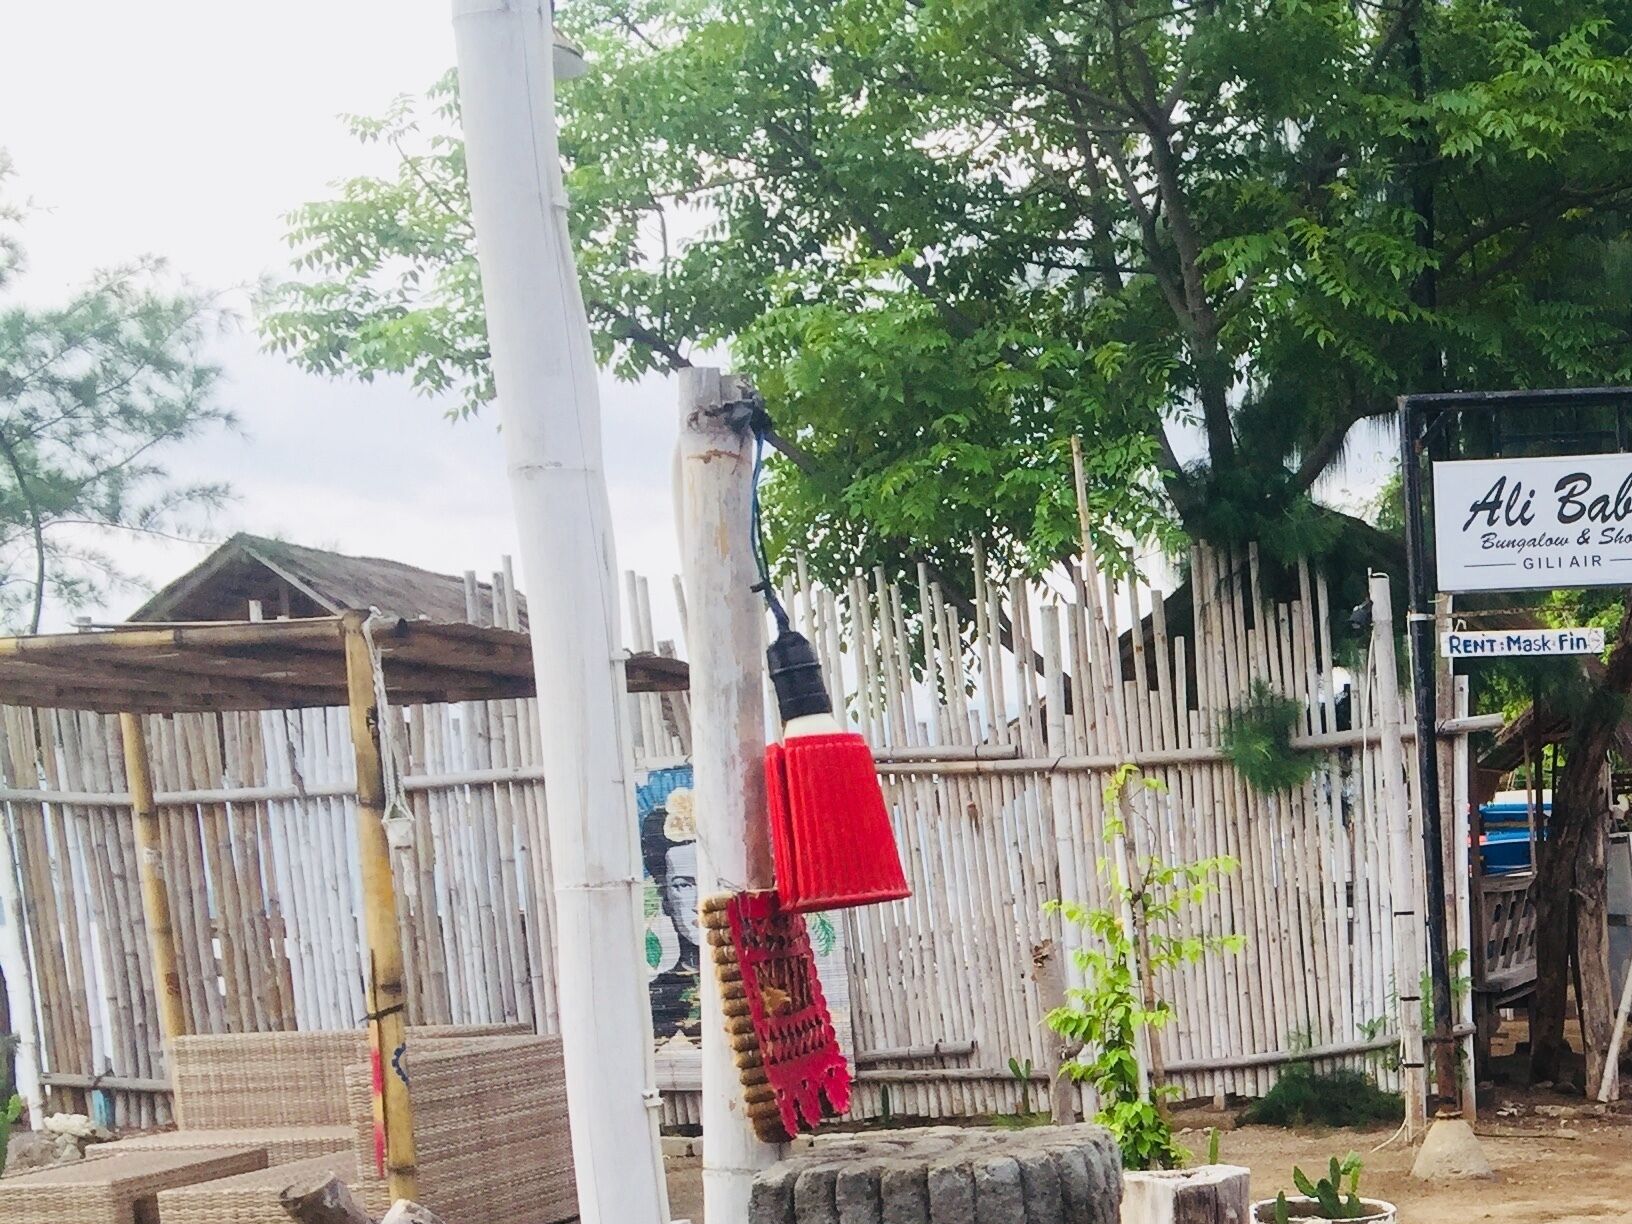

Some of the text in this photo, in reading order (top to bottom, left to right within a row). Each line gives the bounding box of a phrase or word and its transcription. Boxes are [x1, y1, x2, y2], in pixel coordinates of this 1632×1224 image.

[1462, 475, 1536, 532] Ali
[1480, 532, 1569, 553] Bungalow
[1577, 528, 1590, 545] &
[1523, 555, 1603, 570] GILI AIR
[1506, 634, 1551, 653] Mask
[1558, 631, 1588, 651] Fin
